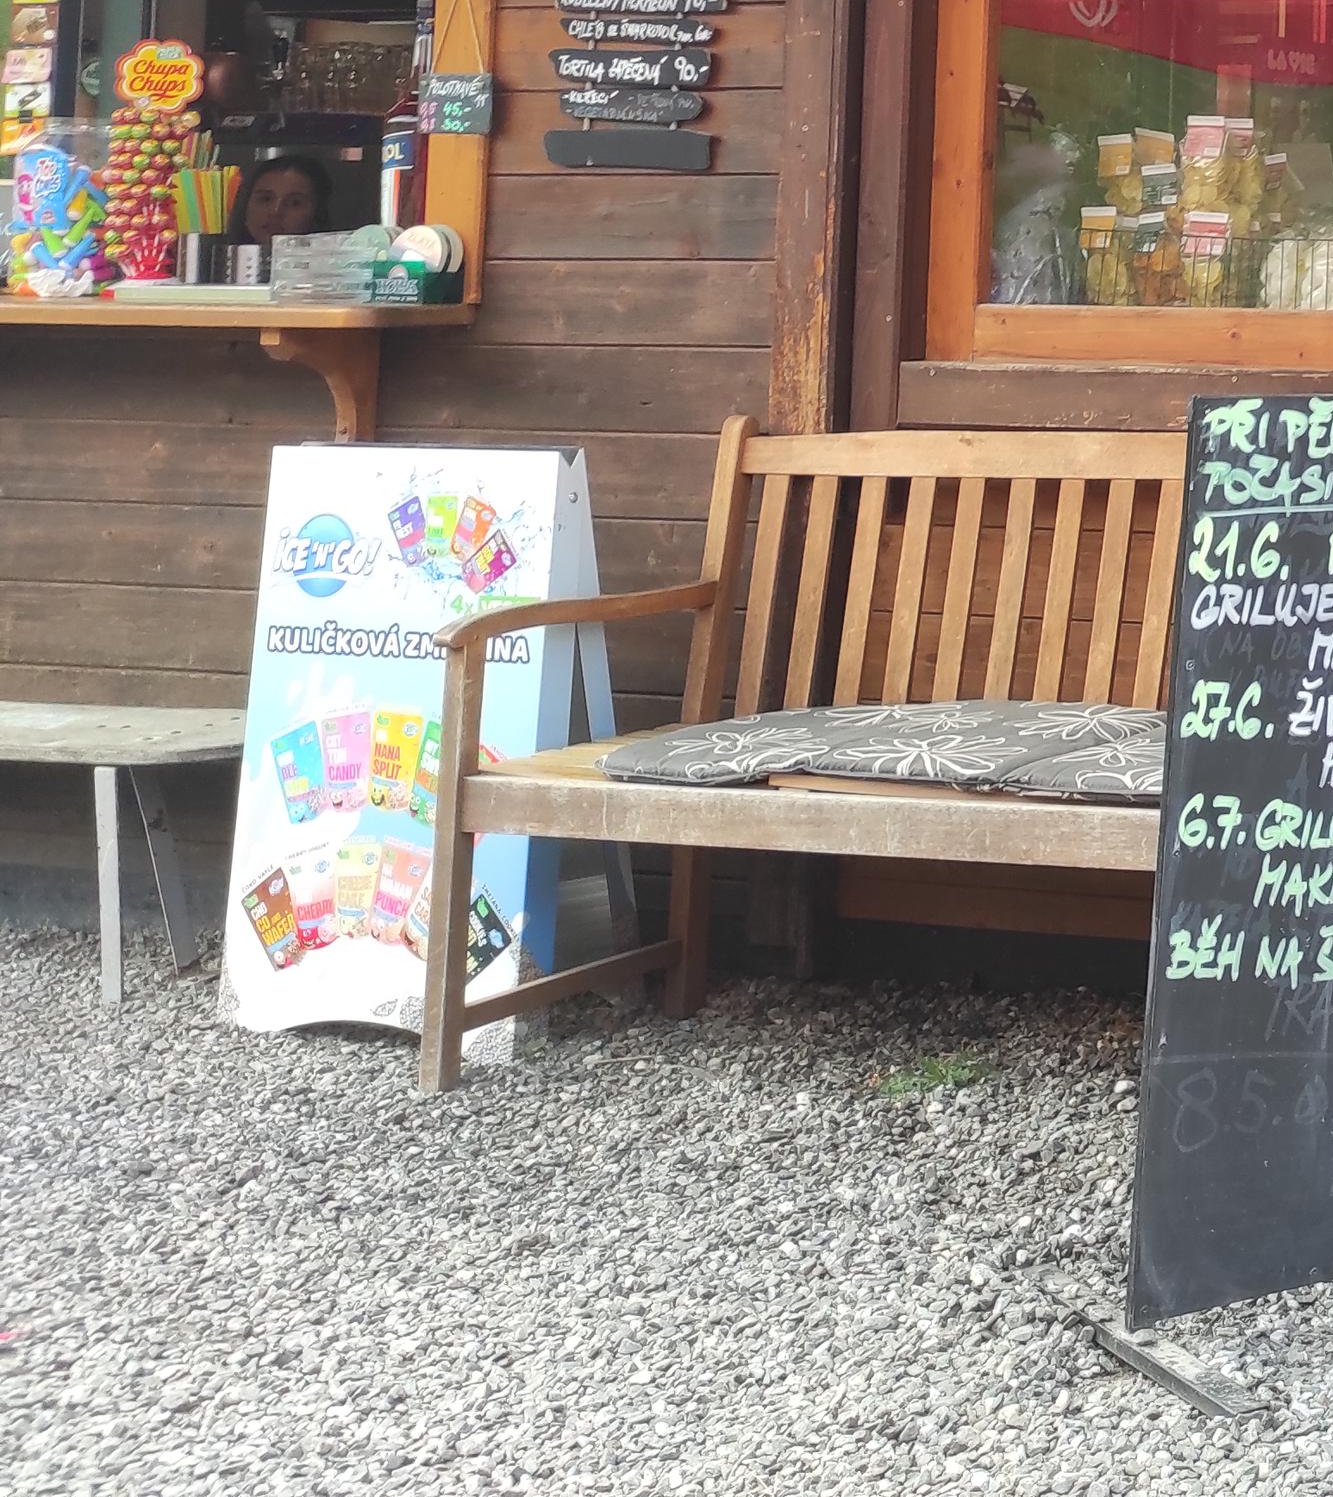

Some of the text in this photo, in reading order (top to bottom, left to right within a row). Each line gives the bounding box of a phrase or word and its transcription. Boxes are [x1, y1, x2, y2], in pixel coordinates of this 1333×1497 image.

[133, 59, 191, 79] Chupa
[558, 54, 605, 84] TORTILA
[674, 55, 709, 83] 90,-
[130, 75, 187, 100] Chups
[1202, 398, 1270, 453] PŘI
[1188, 517, 1289, 583] 21.6.
[267, 621, 400, 658] KULIČKOVÁ
[1179, 679, 1274, 742] 27.6.
[374, 743, 401, 762] NANA
[328, 763, 363, 781] CANDY
[372, 759, 402, 780] SPLIT
[1178, 793, 1246, 850] 6.7.
[250, 901, 268, 921] CHO
[297, 898, 335, 922] CHERRY
[375, 890, 410, 917] PUNCH
[255, 915, 271, 932] CO
[262, 913, 295, 945] WAFER
[1165, 913, 1246, 982] BĚH
[1254, 935, 1304, 990] NA
